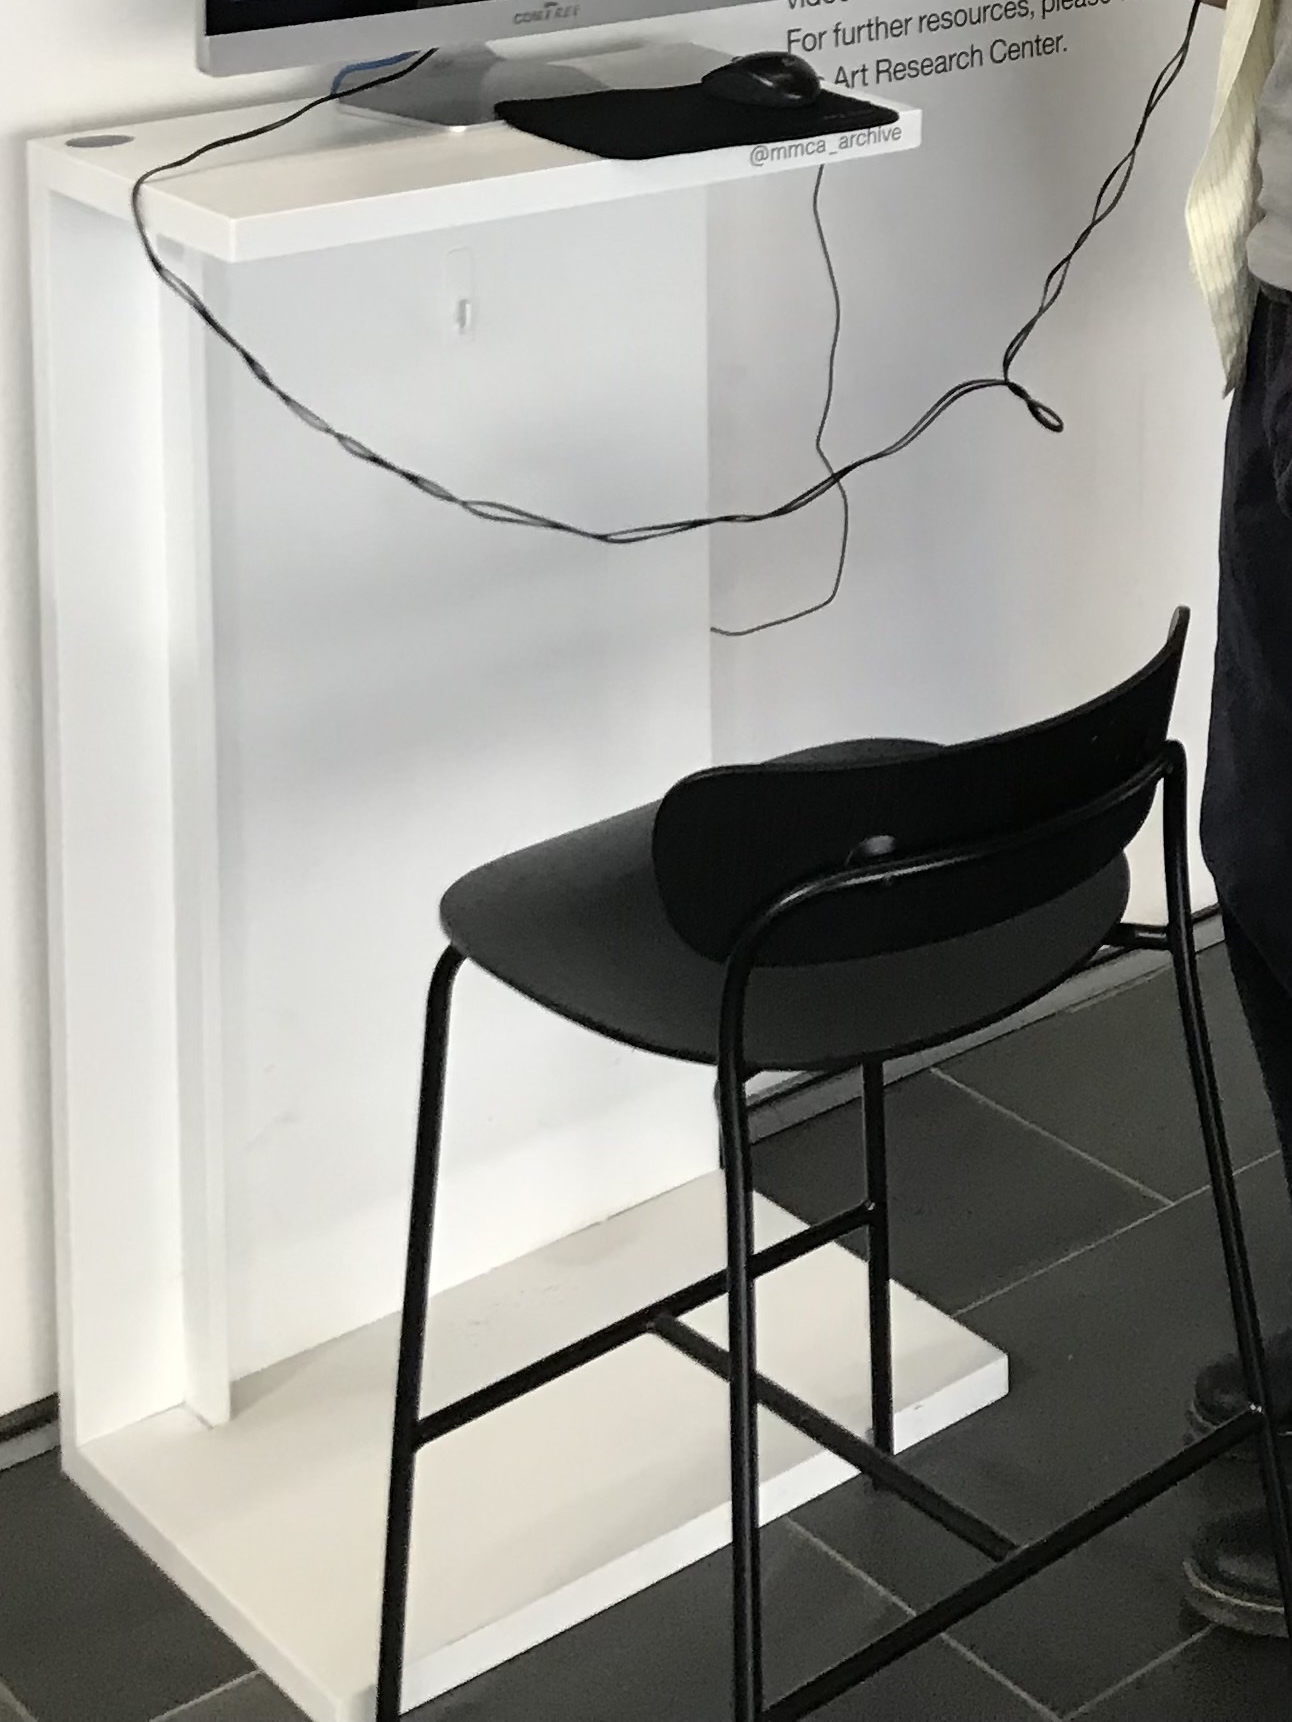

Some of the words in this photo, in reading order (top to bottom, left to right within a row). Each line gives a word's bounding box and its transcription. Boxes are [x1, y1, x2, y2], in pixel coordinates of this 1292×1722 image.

[786, 27, 827, 55] For
[833, 16, 913, 48] further
[834, 65, 869, 89] Art
[875, 43, 984, 85] Research
[989, 34, 1068, 65] Center.
[749, 124, 903, 166] @mmca_archive
